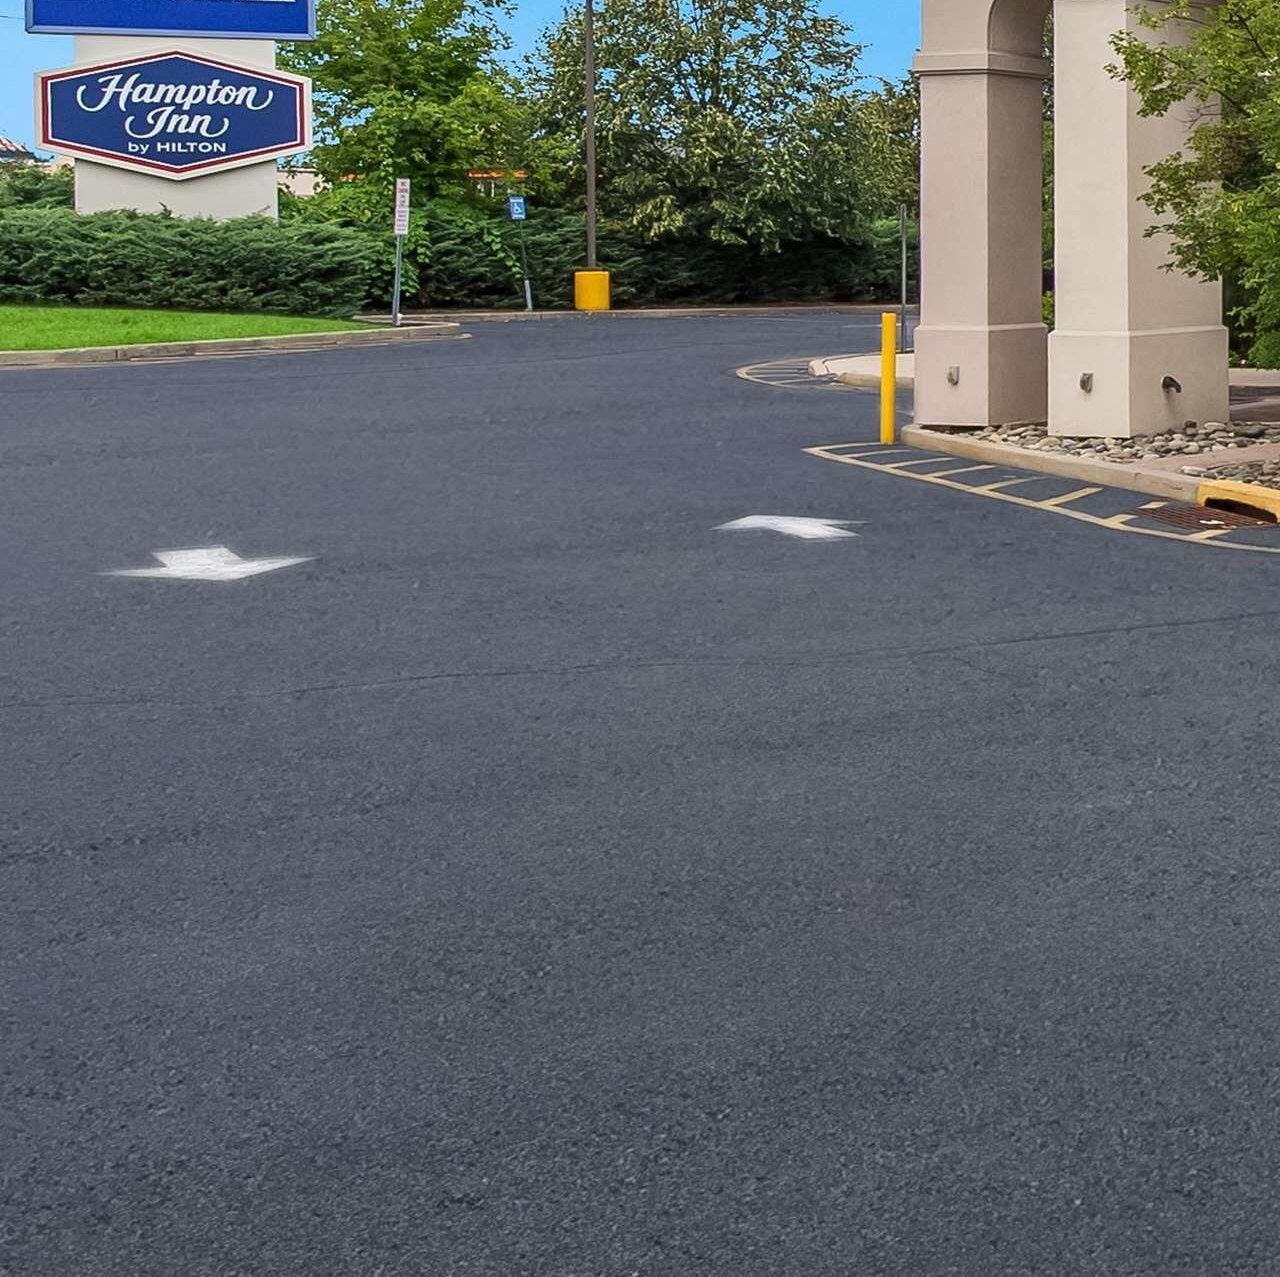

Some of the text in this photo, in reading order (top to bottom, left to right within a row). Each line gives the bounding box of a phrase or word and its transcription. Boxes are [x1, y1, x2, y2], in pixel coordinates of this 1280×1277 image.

[76, 73, 273, 112] Hampton
[125, 106, 229, 138] Inn
[128, 142, 226, 154] by HILTON
